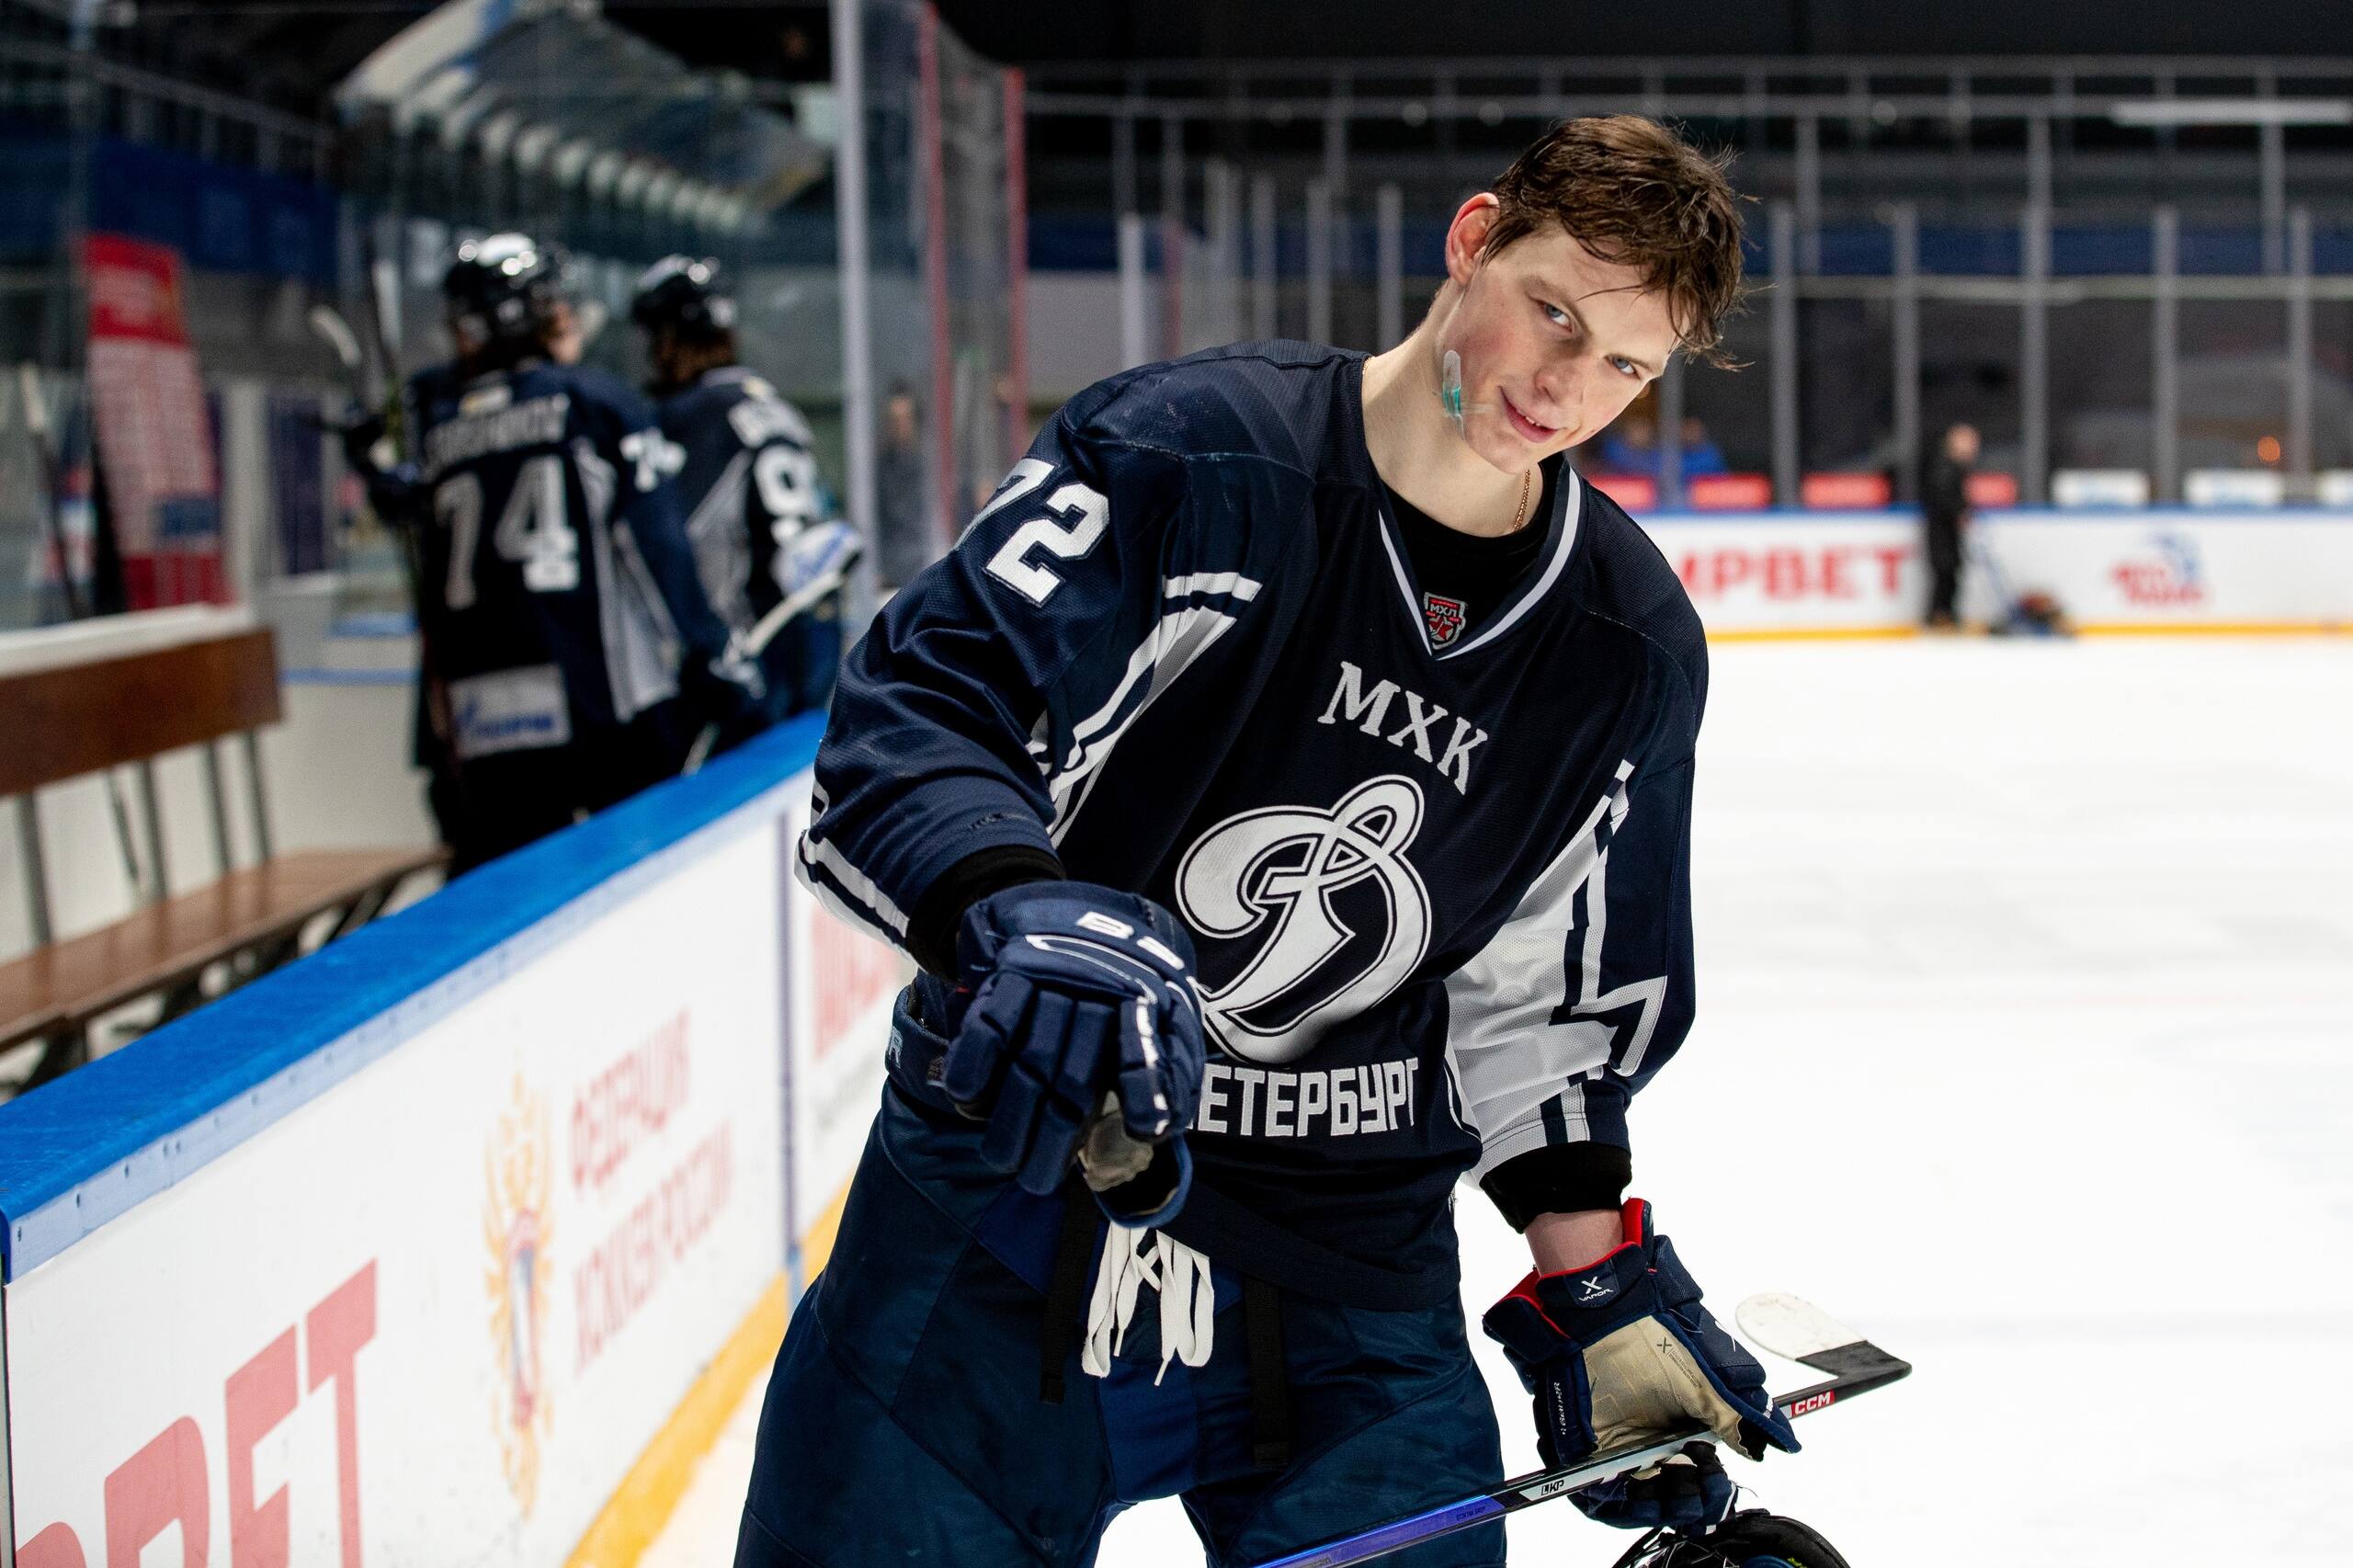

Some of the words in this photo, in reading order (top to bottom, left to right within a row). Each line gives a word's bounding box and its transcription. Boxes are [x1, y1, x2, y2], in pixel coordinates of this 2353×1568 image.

[953, 458, 1109, 605] 72
[1317, 661, 1488, 796] МХК
[1189, 1056, 1419, 1138] ЕТЕРБУРГ
[1794, 1391, 1831, 1415] CCM
